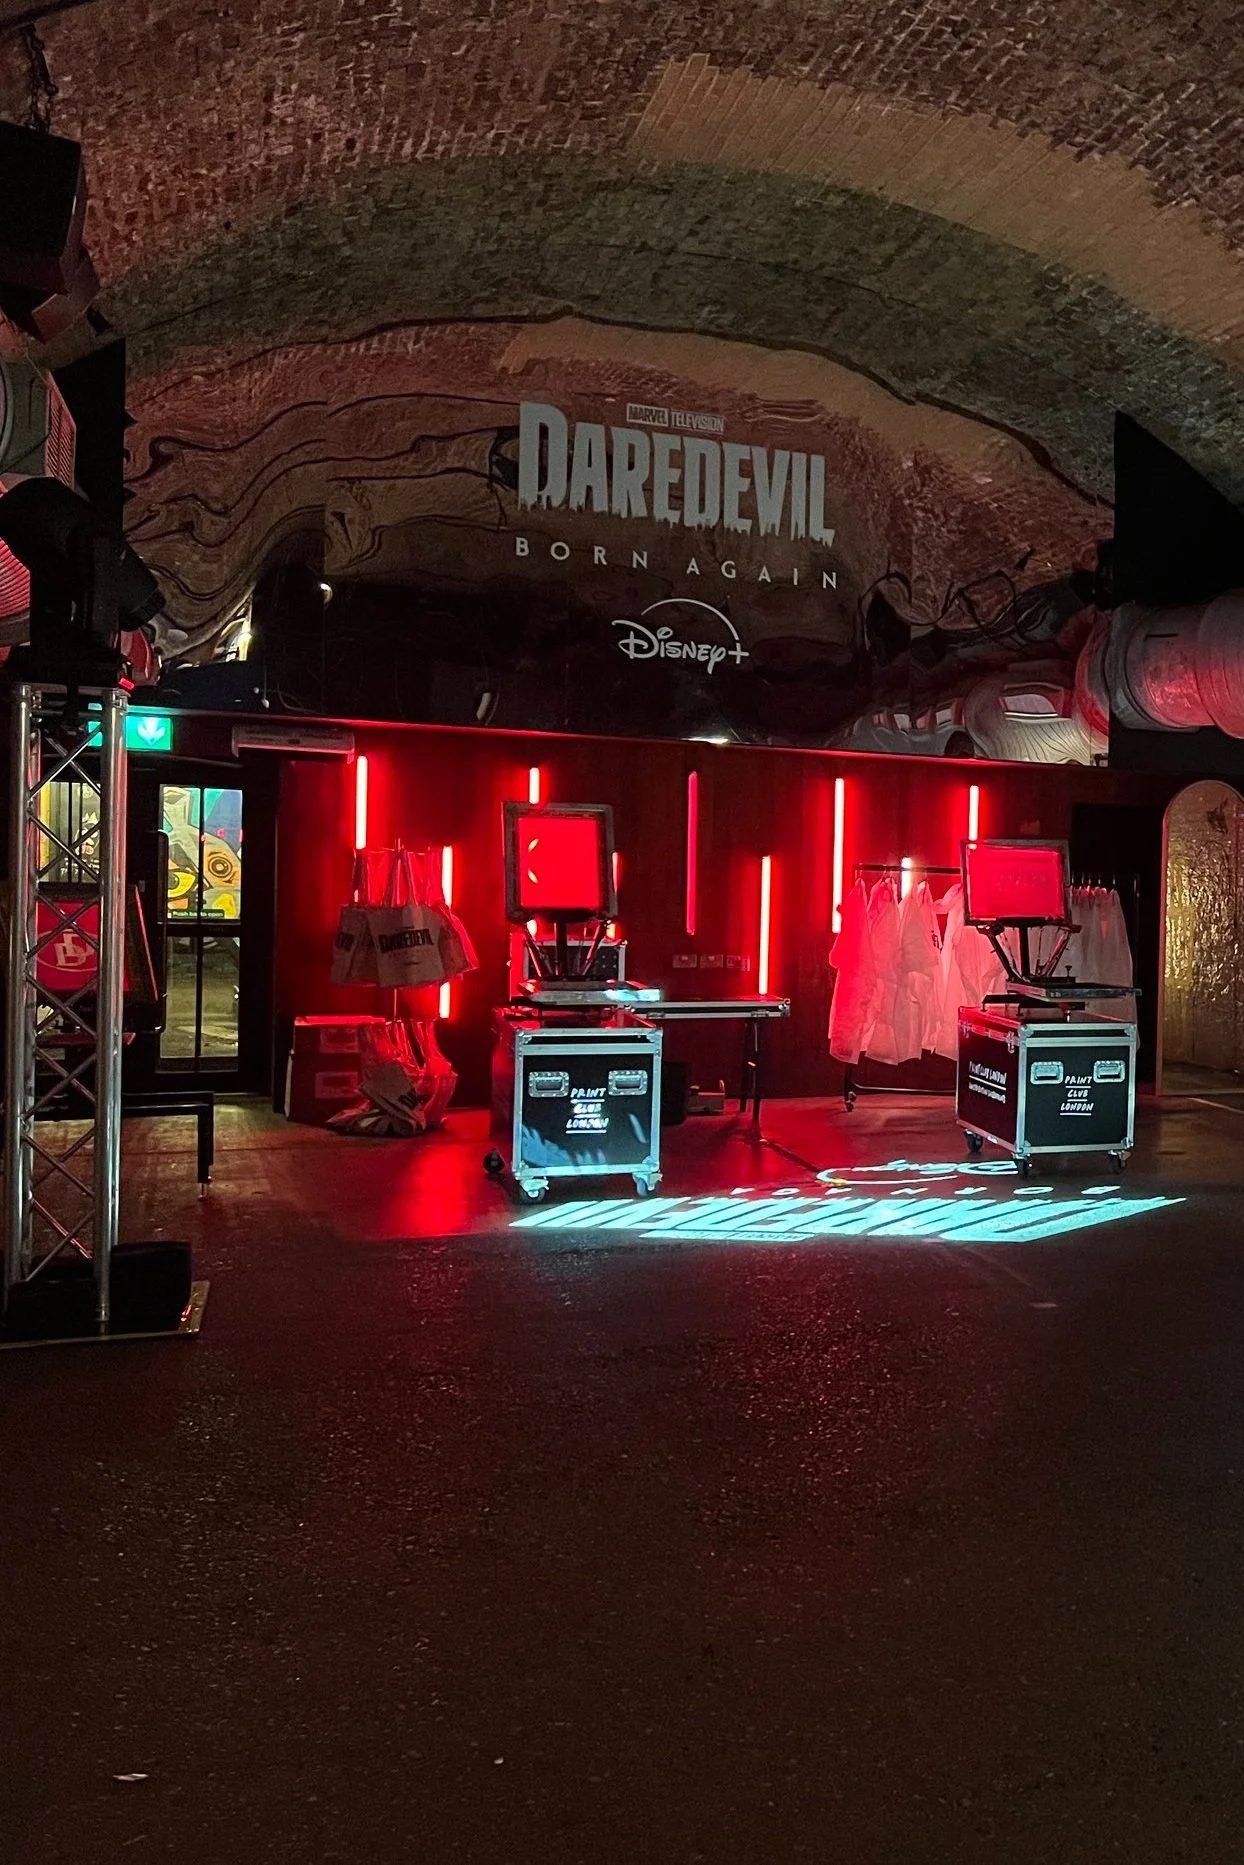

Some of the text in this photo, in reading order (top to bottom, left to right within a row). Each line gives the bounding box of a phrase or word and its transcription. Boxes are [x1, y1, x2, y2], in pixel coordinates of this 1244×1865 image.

[628, 405, 725, 433] MARVEL TELEVISION
[518, 400, 835, 547] DAREDEVIL
[516, 537, 838, 589] BORN AGAIN
[1067, 1089, 1089, 1098] CLUB
[1060, 1102, 1095, 1111] LONDON
[565, 1117, 609, 1129] LONDON
